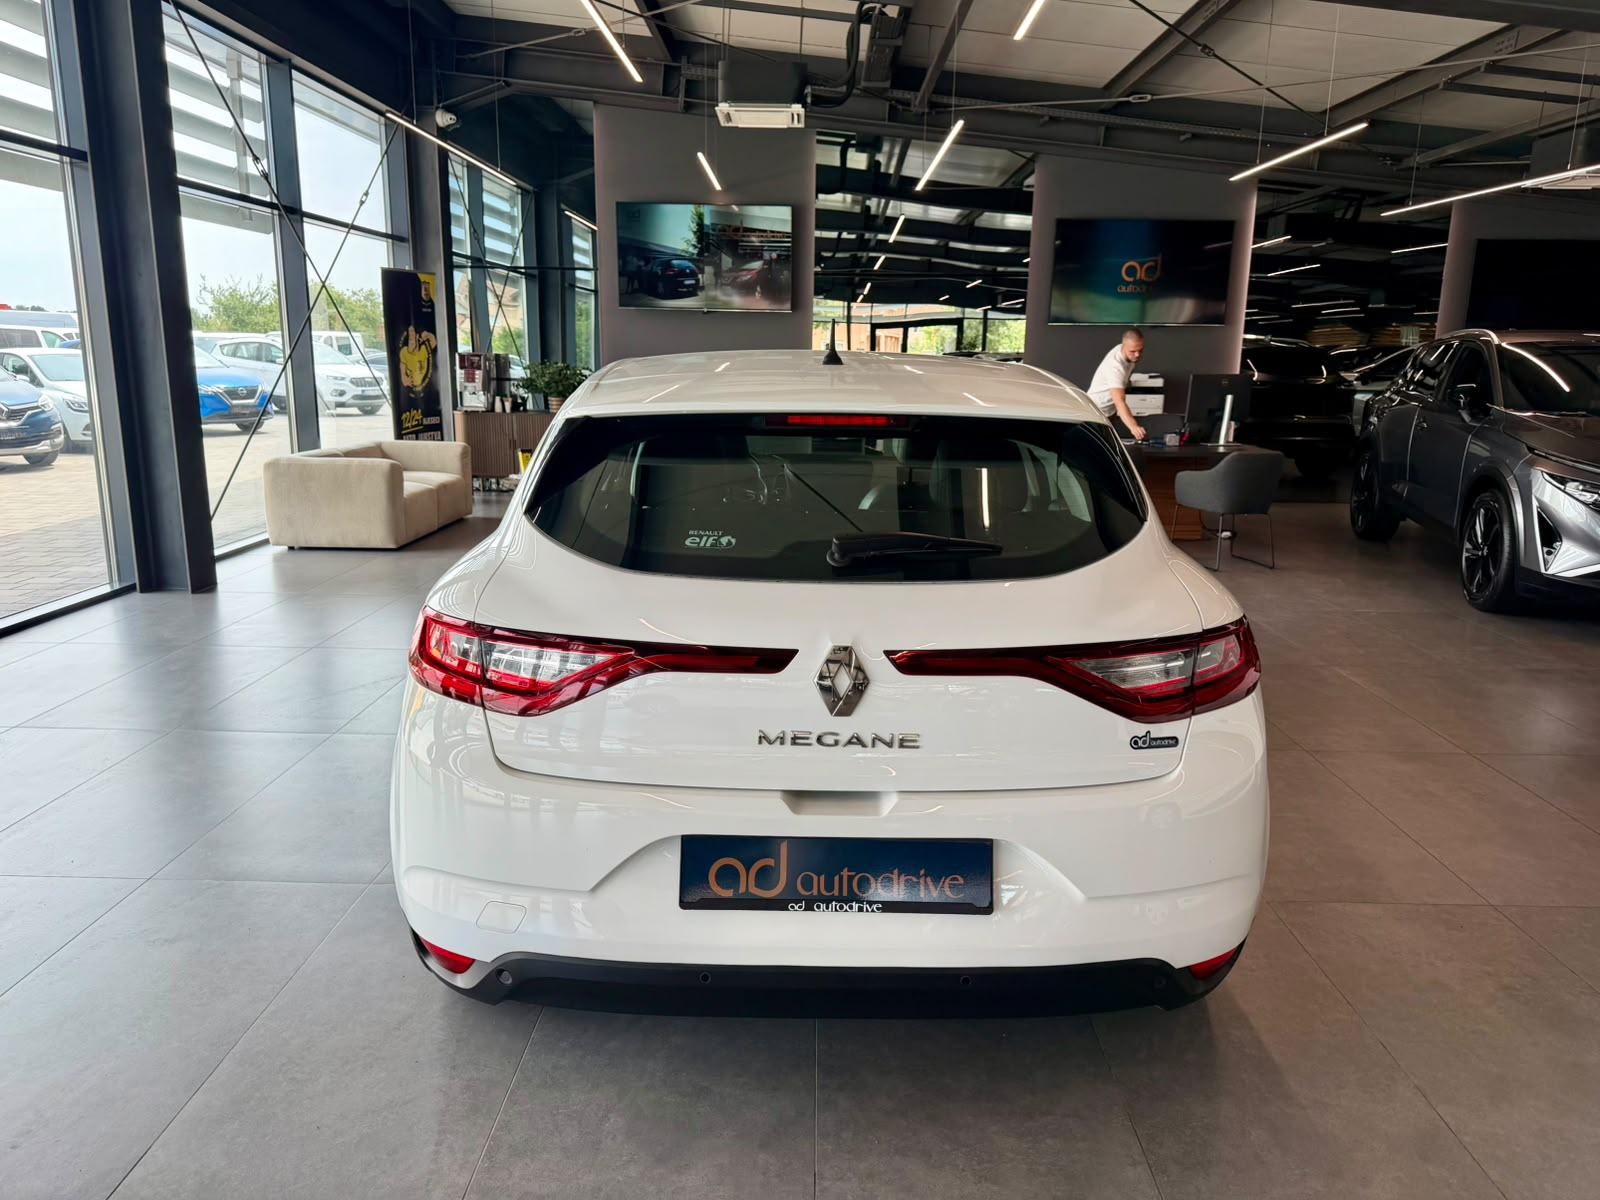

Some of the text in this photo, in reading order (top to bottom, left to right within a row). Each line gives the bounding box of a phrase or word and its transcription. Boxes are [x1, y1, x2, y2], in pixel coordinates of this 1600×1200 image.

[1121, 253, 1162, 282] ad
[757, 729, 921, 749] MEGANE
[1131, 731, 1150, 748] ad
[708, 840, 965, 898] ad autodrive
[787, 900, 882, 912] ad autodrive
